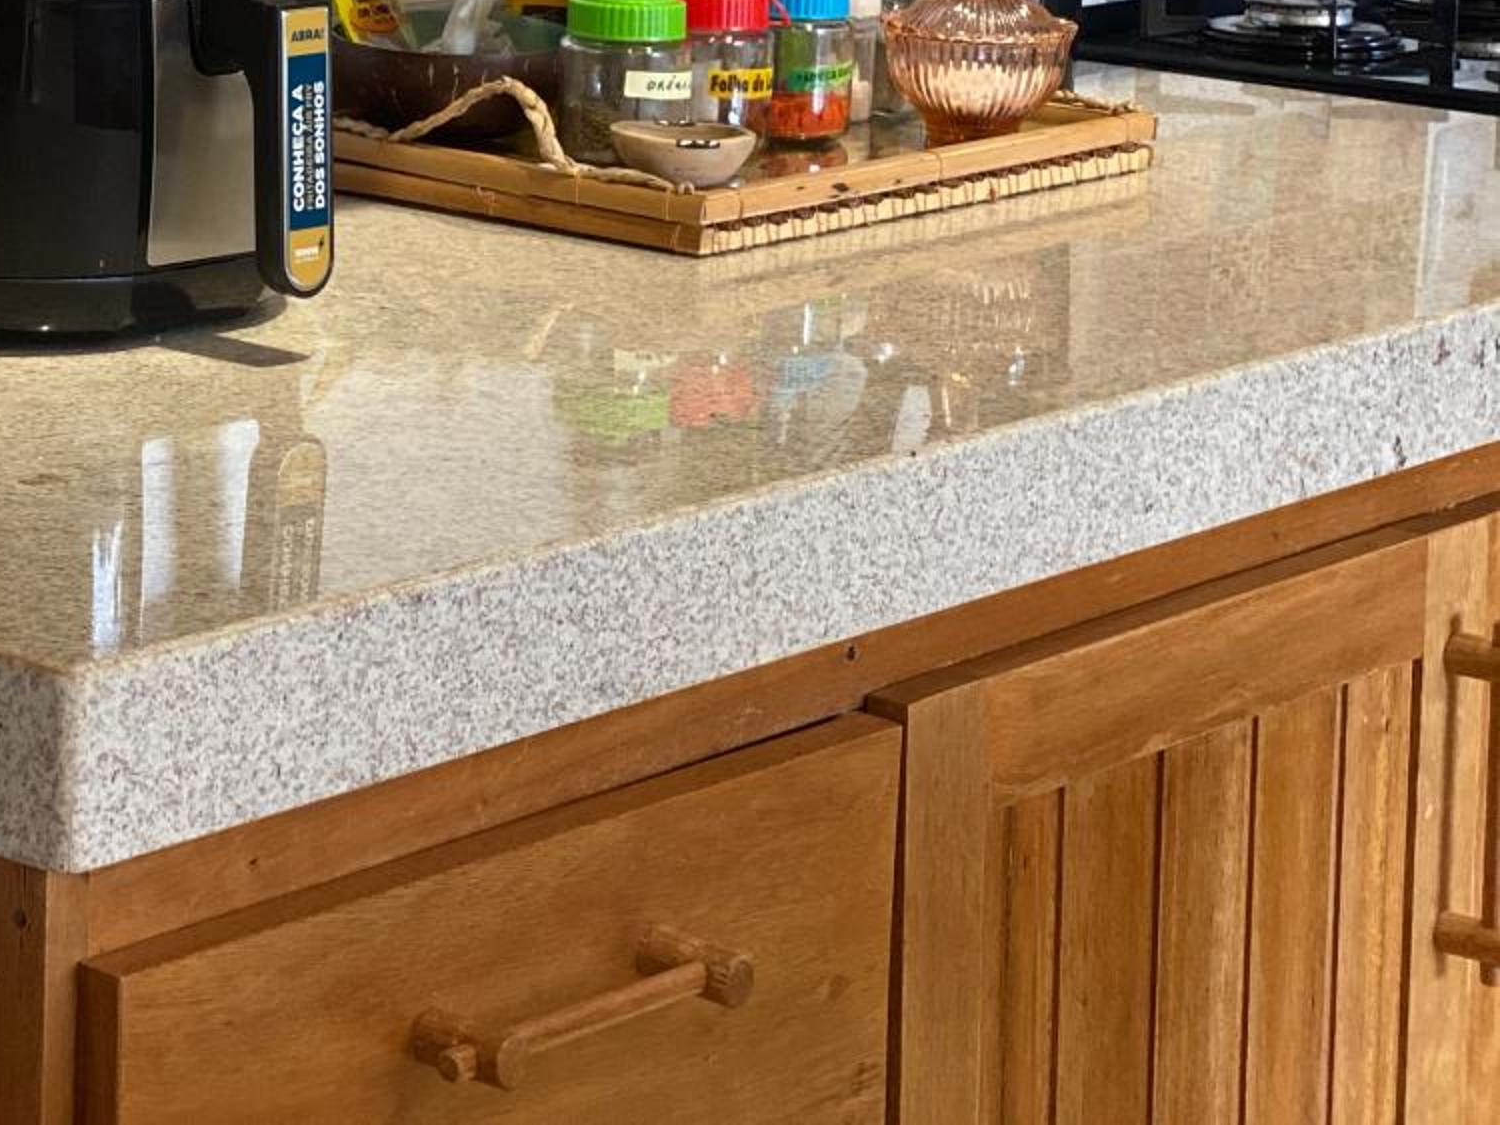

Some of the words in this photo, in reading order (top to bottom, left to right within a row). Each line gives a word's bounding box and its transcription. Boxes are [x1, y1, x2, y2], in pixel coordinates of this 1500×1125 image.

[291, 84, 304, 102] A
[313, 81, 325, 164] SONHOS
[291, 105, 307, 212] CONHEÇA
[314, 167, 325, 208] DOS
